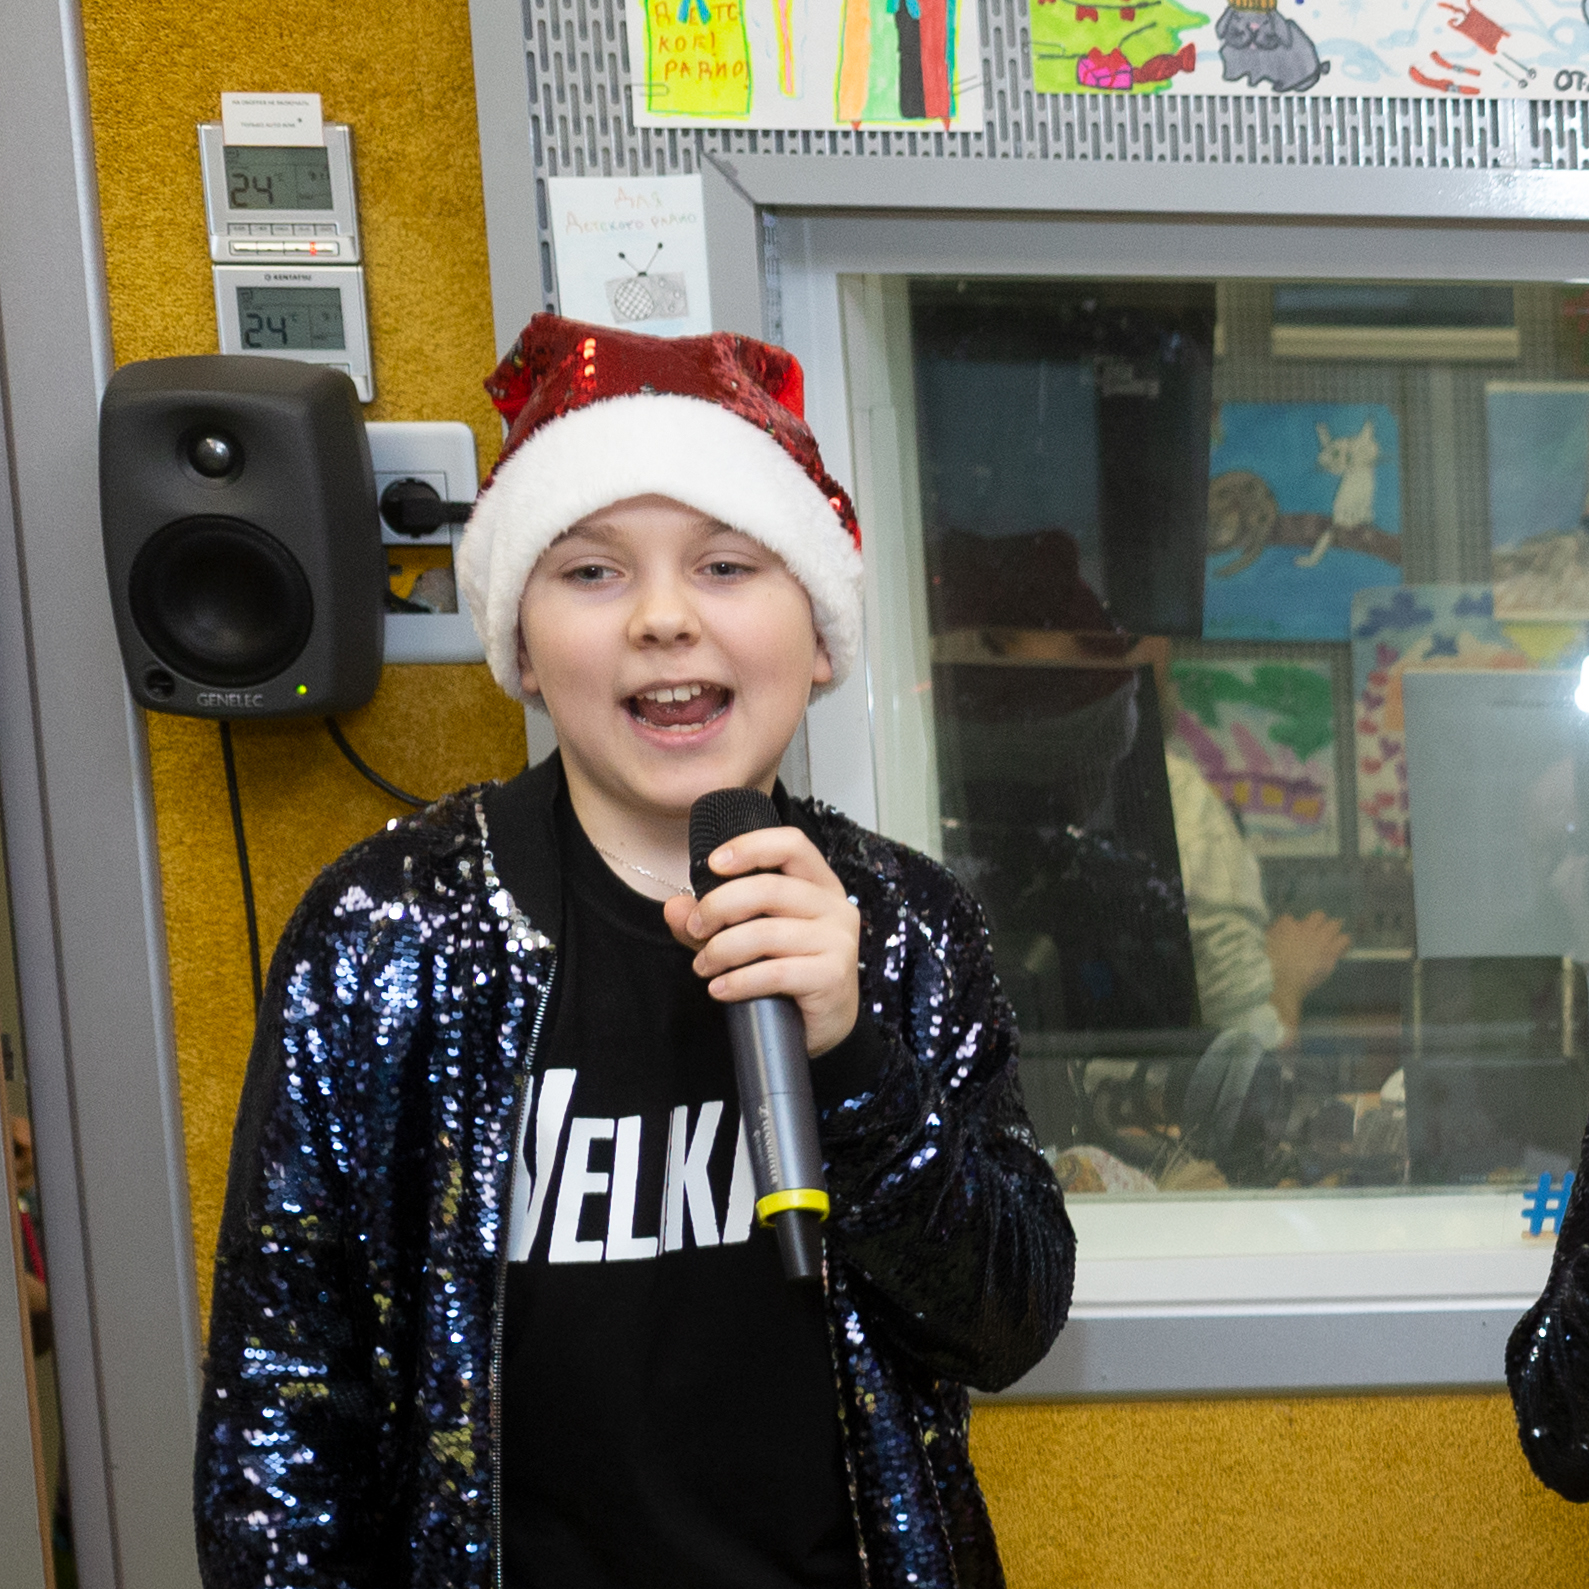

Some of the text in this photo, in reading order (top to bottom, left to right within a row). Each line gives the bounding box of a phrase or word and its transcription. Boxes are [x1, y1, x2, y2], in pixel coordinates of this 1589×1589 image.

[230, 172, 273, 207] 24
[244, 312, 288, 348] 24
[196, 692, 264, 708] GENELEC
